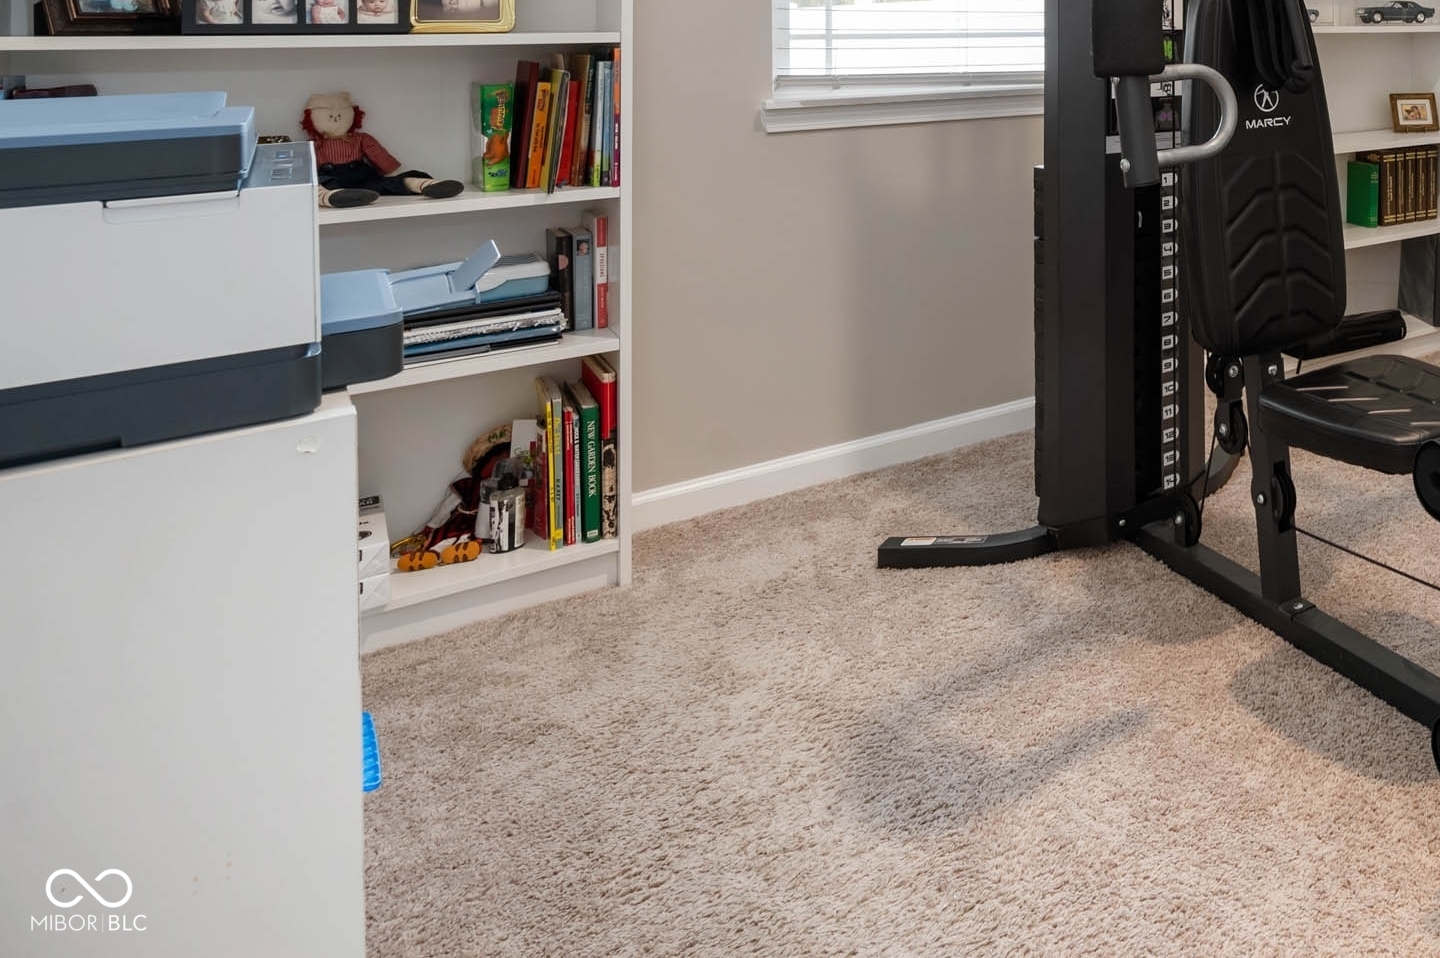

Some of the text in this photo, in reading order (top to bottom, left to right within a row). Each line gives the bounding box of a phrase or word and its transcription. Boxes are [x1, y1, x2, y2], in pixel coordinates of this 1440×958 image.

[1245, 116, 1291, 129] MARCY
[587, 420, 597, 497] NEW GARDEN BOOK
